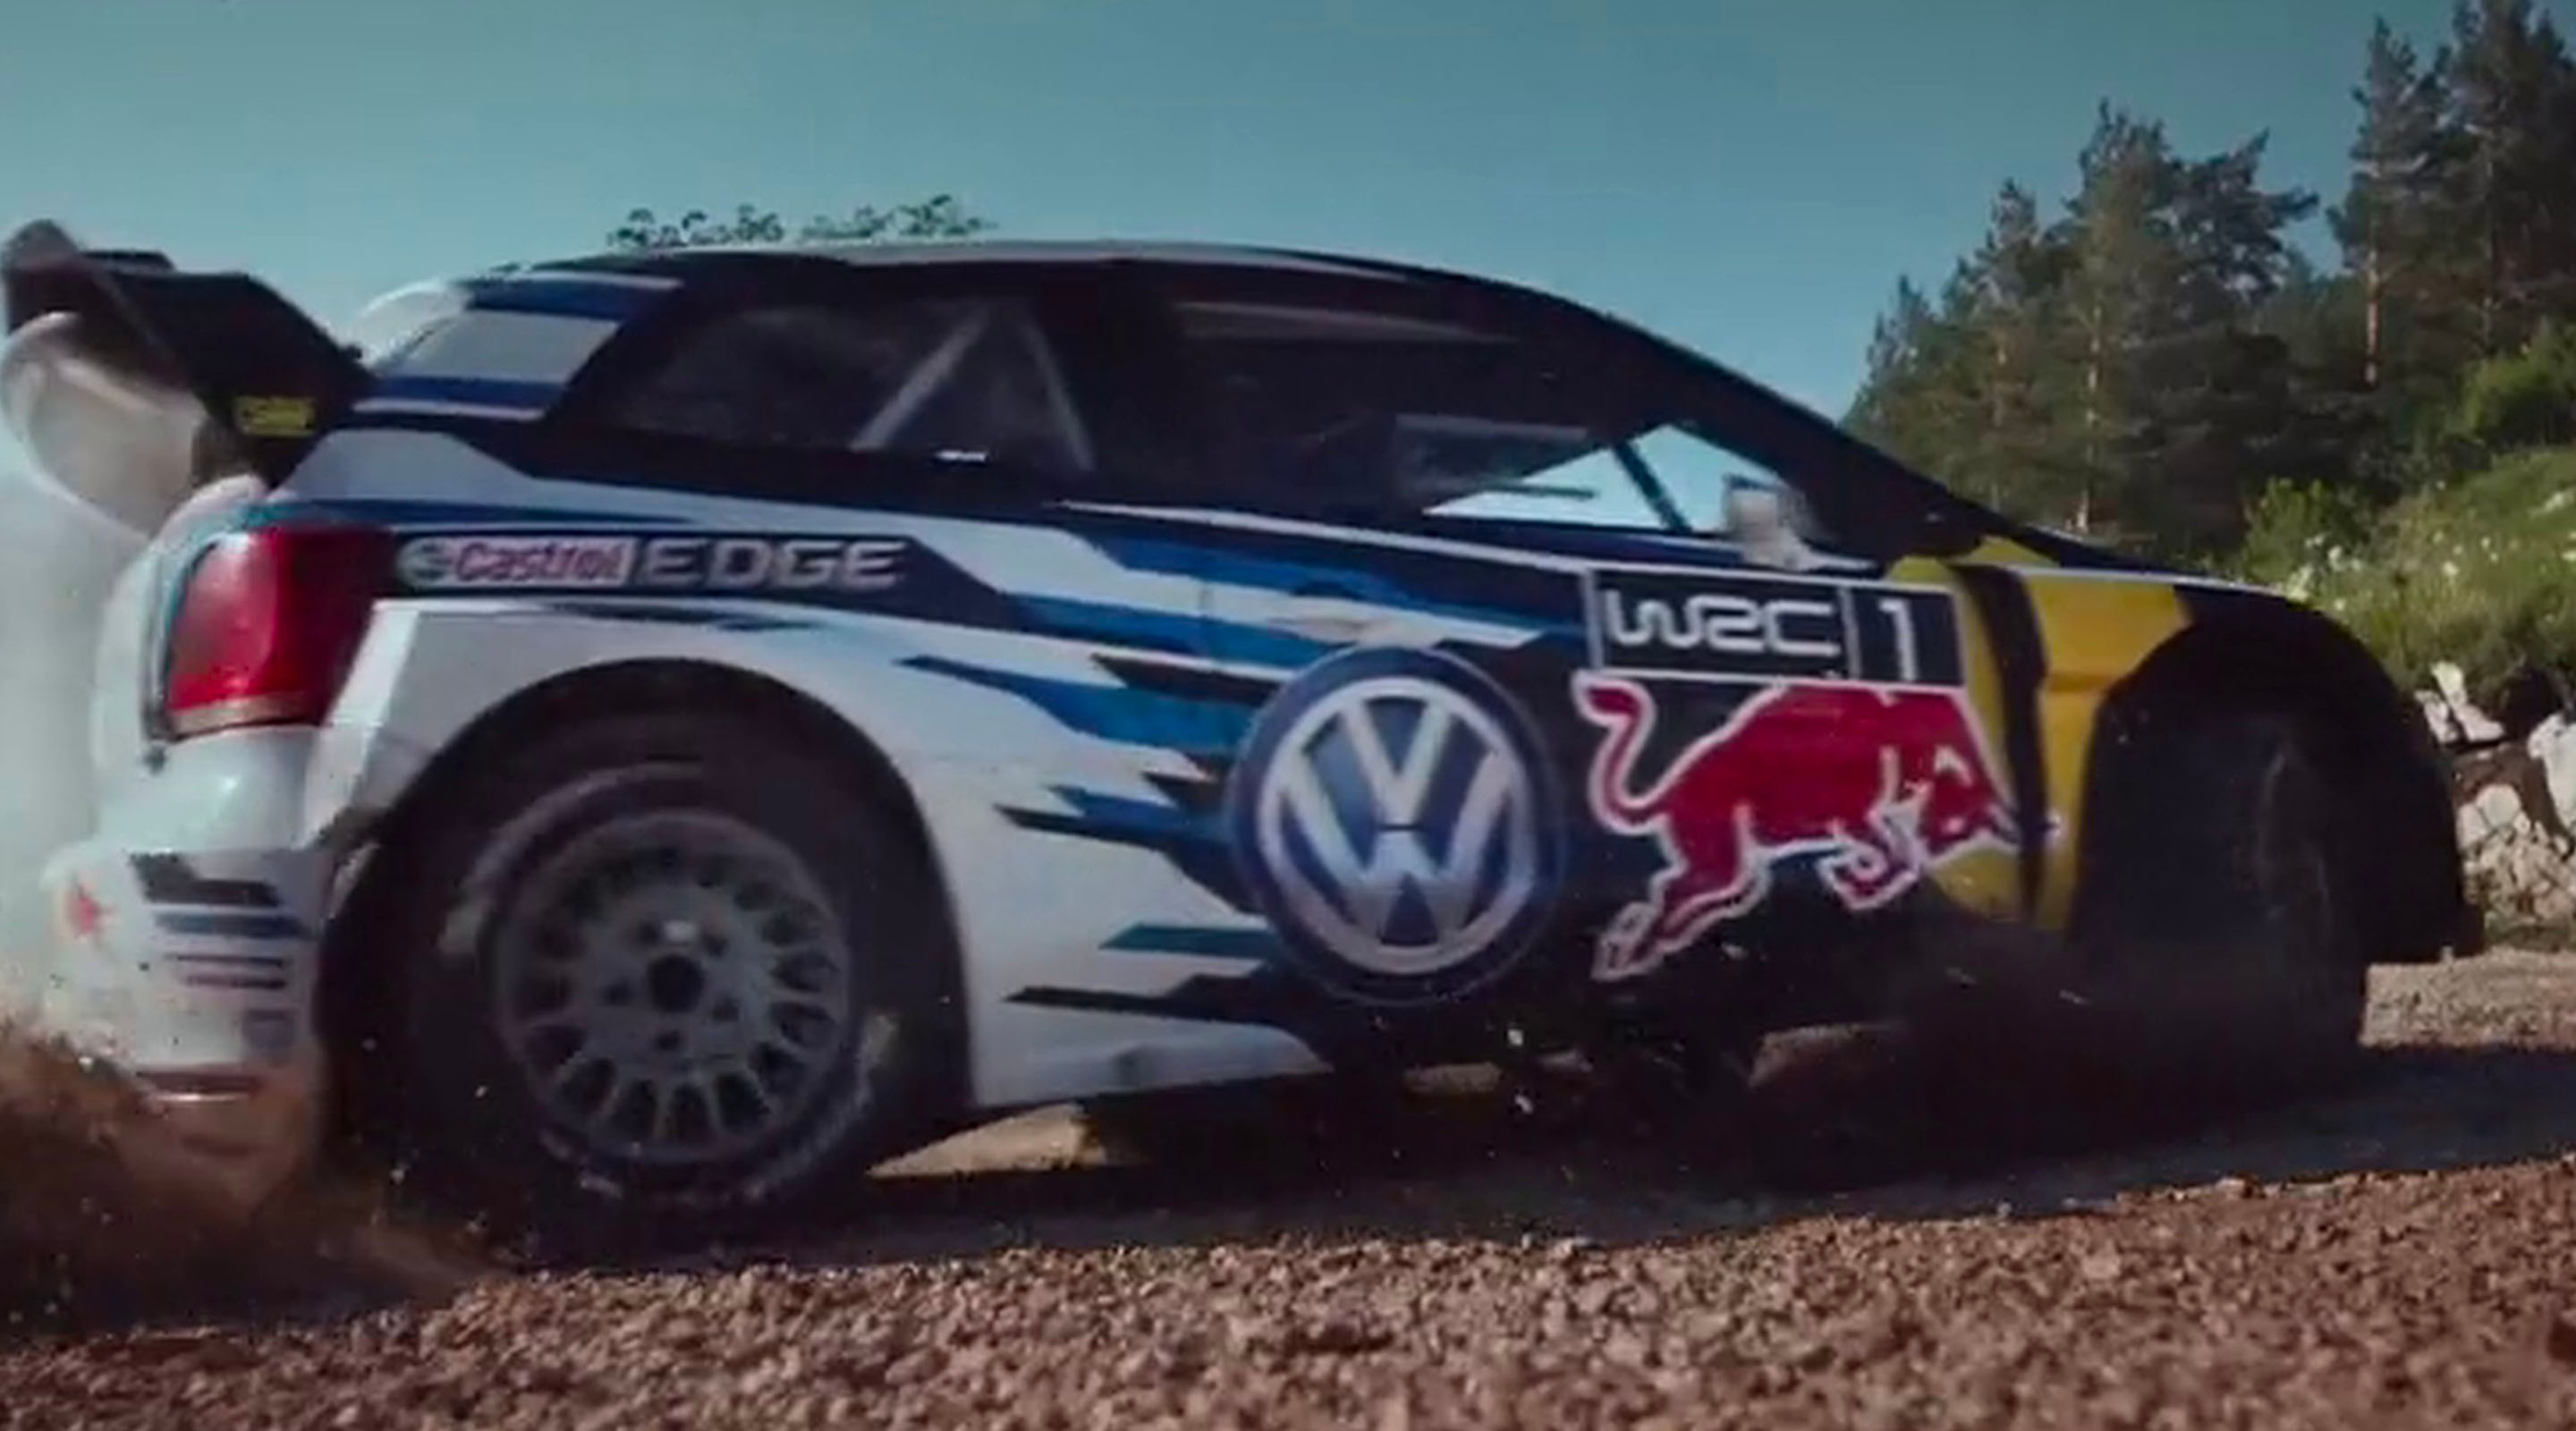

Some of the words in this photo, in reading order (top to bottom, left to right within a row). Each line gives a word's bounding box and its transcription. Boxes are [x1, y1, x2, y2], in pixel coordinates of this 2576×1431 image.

[455, 540, 626, 582] Castrol
[636, 538, 907, 590] EDGE
[1606, 588, 1842, 657] WRC
[1881, 598, 1917, 681] 1
